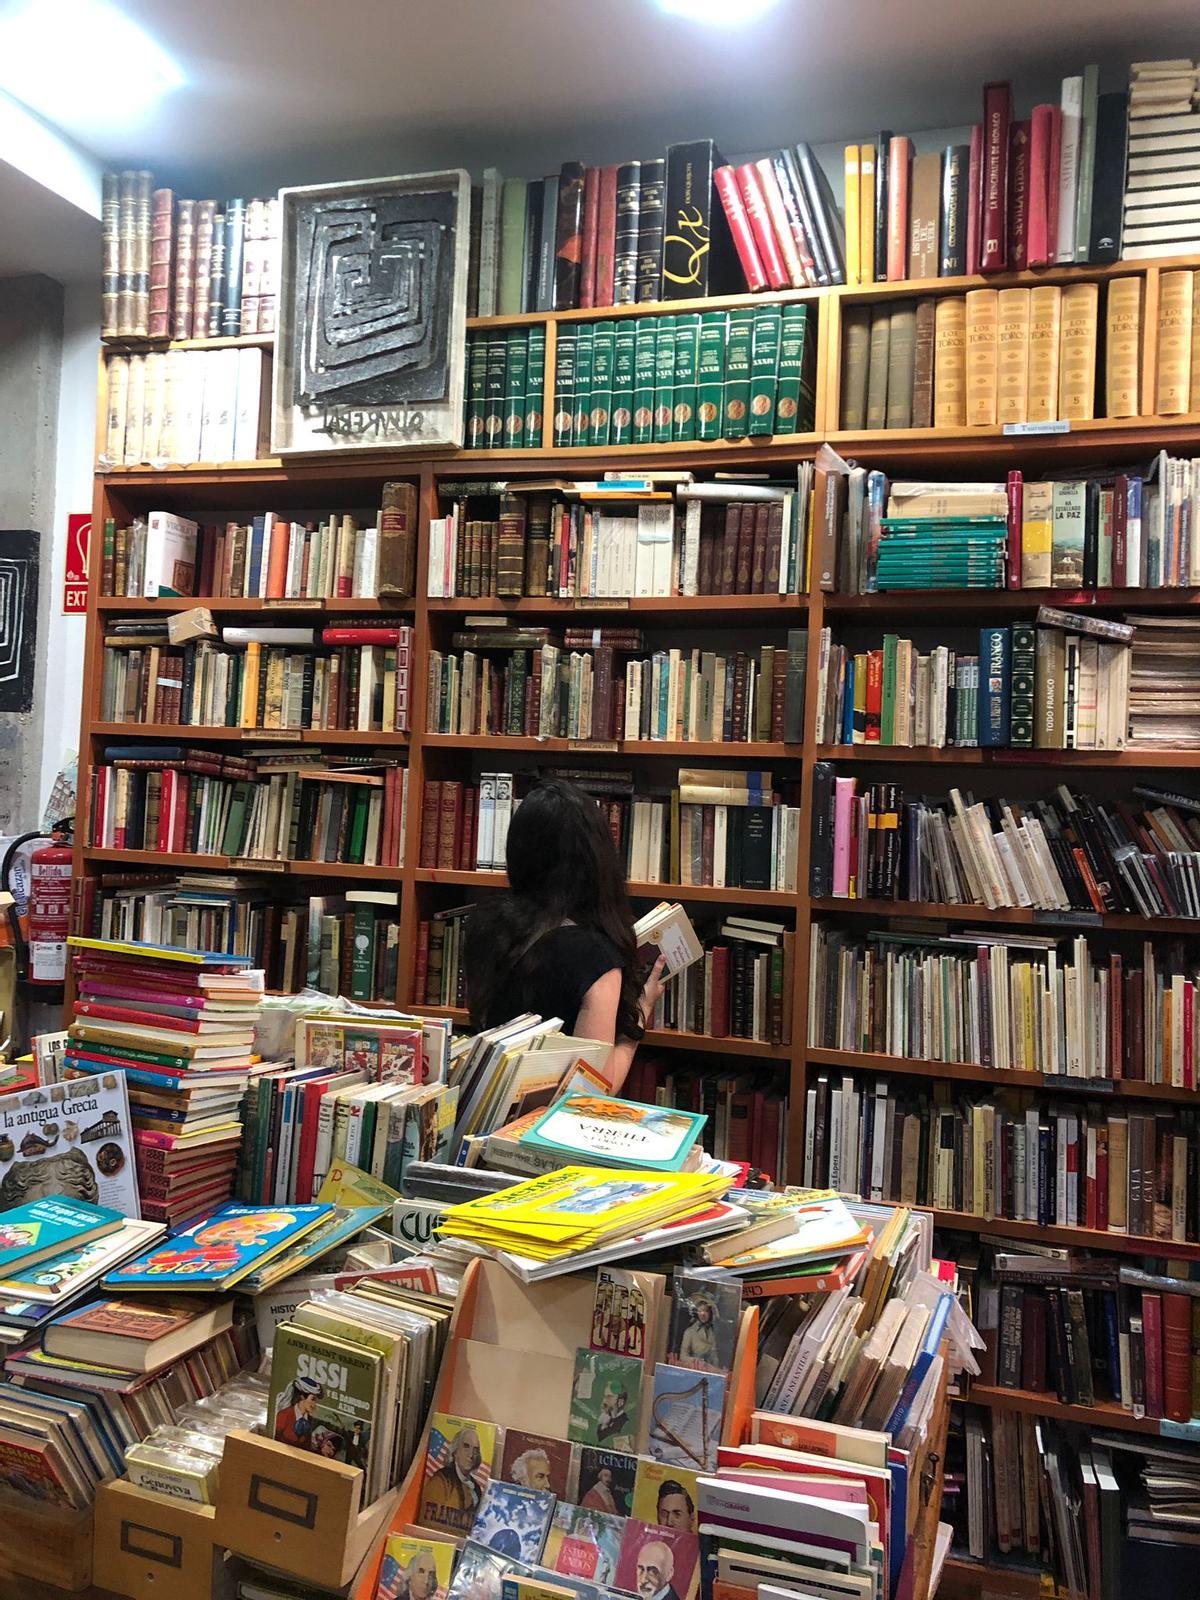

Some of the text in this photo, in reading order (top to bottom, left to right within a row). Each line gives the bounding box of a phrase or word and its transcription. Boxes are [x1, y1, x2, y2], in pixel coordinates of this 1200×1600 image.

[990, 633, 1003, 675] FRANCO
[1046, 679, 1055, 732] TODO FRANCO
[4, 1095, 98, 1128] la antigua Grecia
[600, 1272, 614, 1283] EL
[270, 1304, 298, 1314] HISTO
[297, 1354, 348, 1391] SISSI
[140, 1475, 192, 1495] Genoveva
